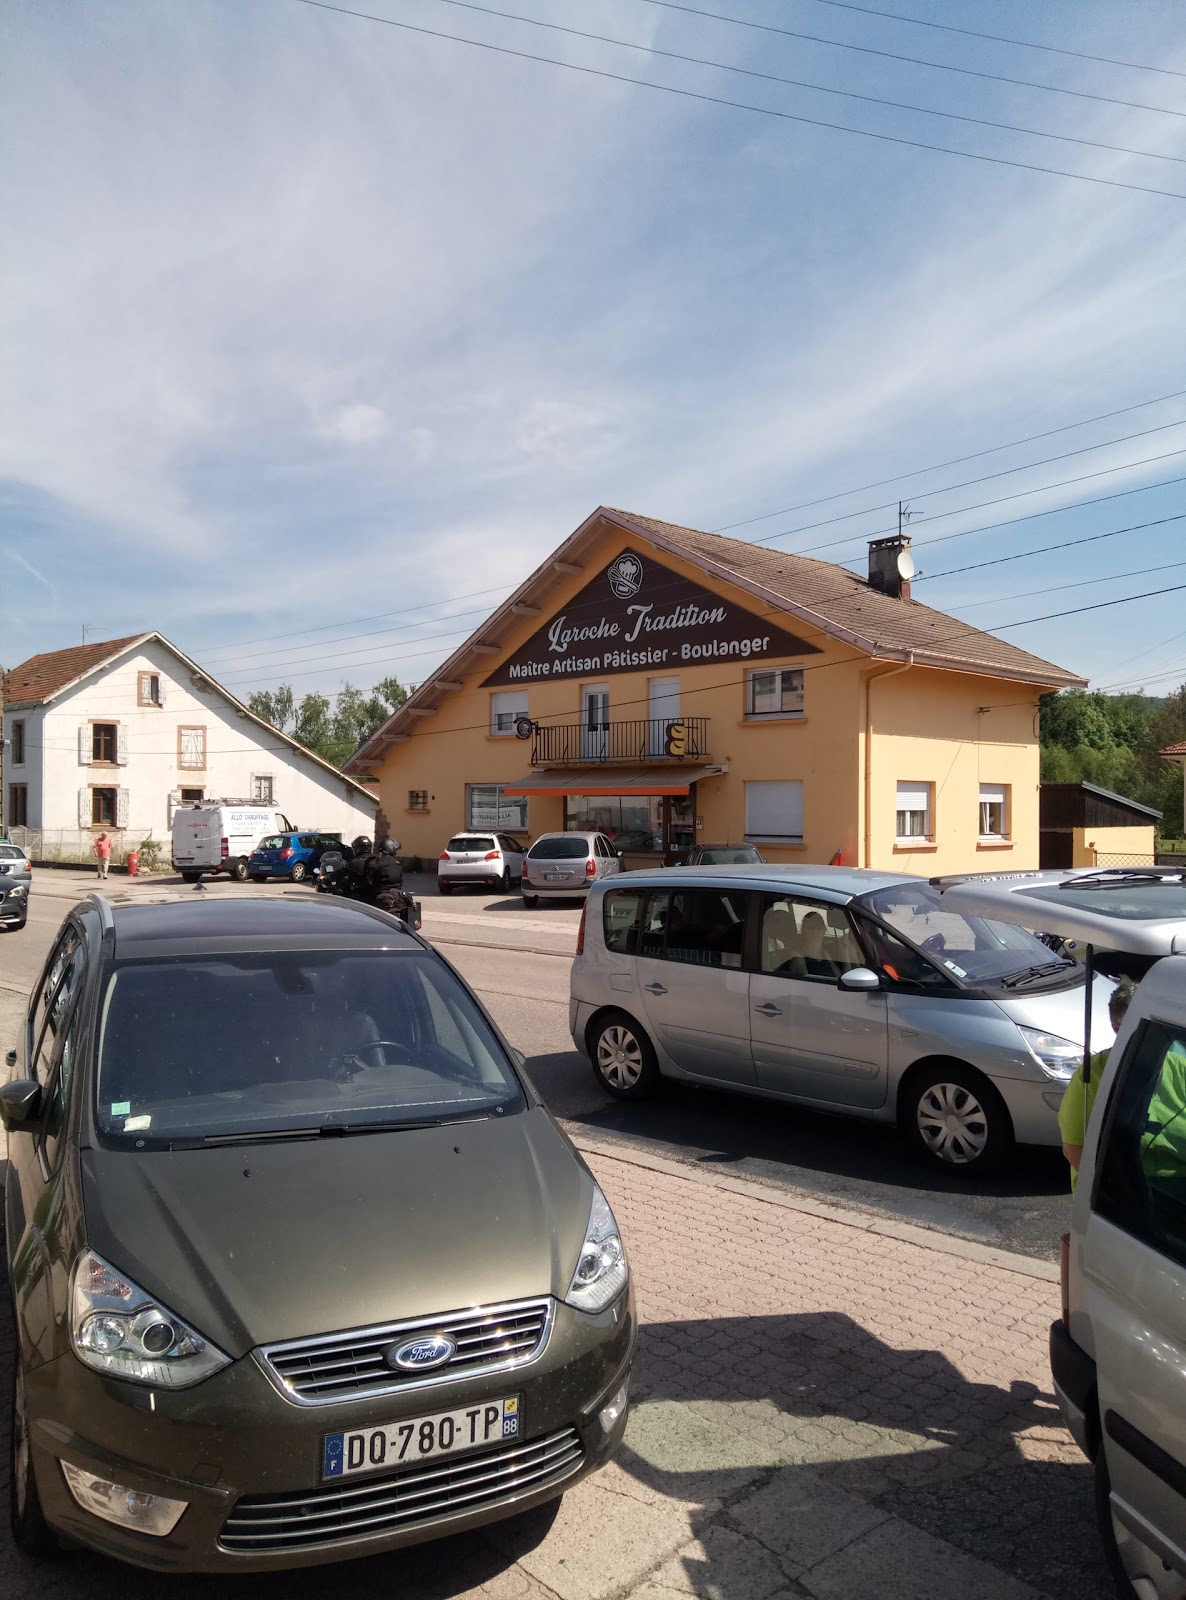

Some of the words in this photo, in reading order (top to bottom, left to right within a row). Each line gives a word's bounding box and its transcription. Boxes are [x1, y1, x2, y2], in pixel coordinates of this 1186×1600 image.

[548, 615, 621, 653] Laroche
[624, 603, 728, 643] Tradition
[509, 661, 550, 679] Maître
[552, 655, 601, 673] Artisan
[603, 646, 669, 668] Pâtissier
[681, 635, 770, 660] Boulanger
[409, 1343, 439, 1362] Ford
[330, 1460, 337, 1471] F
[347, 1405, 500, 1470] DQ-780-TP
[502, 1418, 518, 1435] 88
